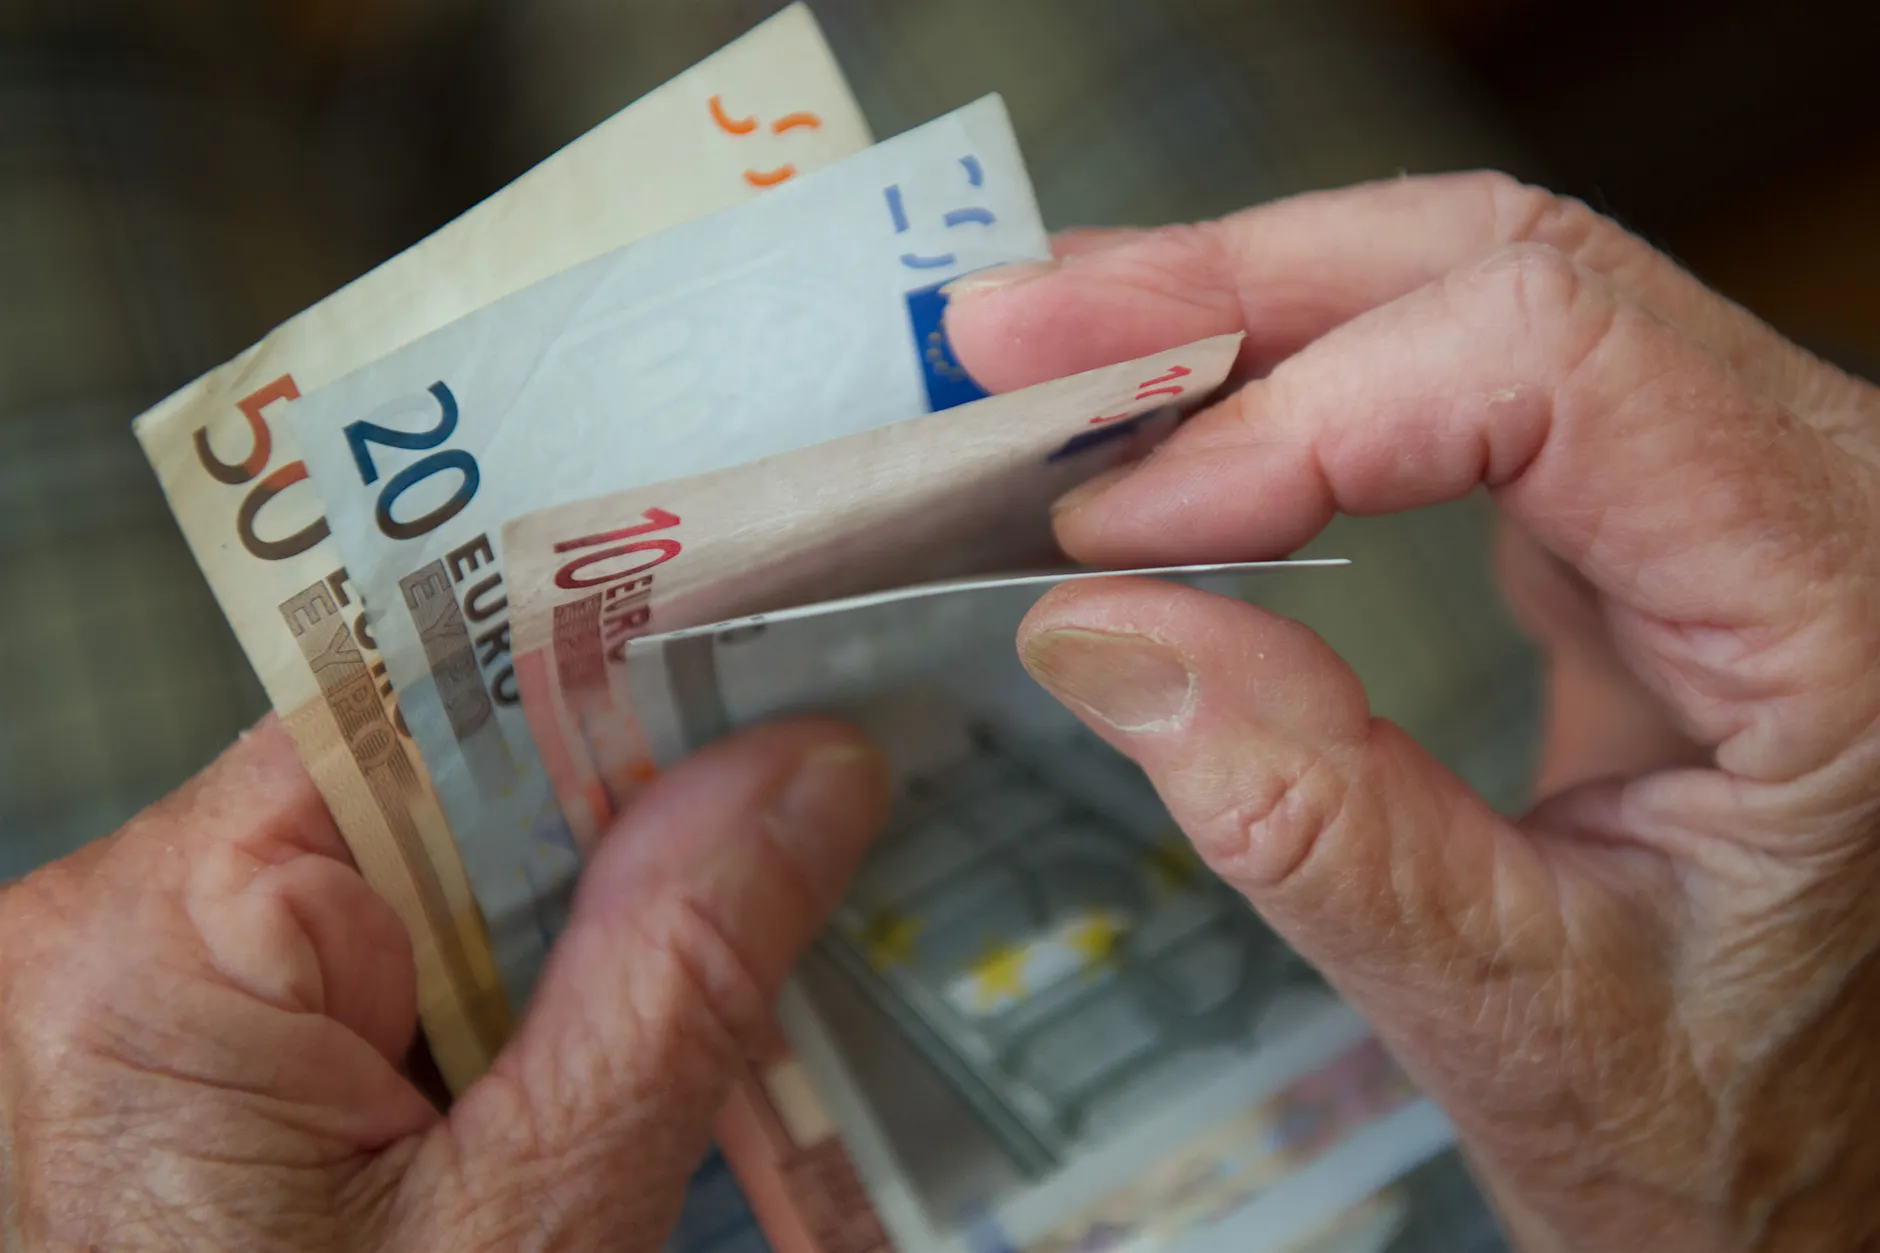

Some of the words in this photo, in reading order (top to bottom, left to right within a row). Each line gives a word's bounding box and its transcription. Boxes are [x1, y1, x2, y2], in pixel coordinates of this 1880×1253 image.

[193, 372, 332, 561] 50
[342, 380, 481, 540] 20
[553, 507, 682, 589] 10
